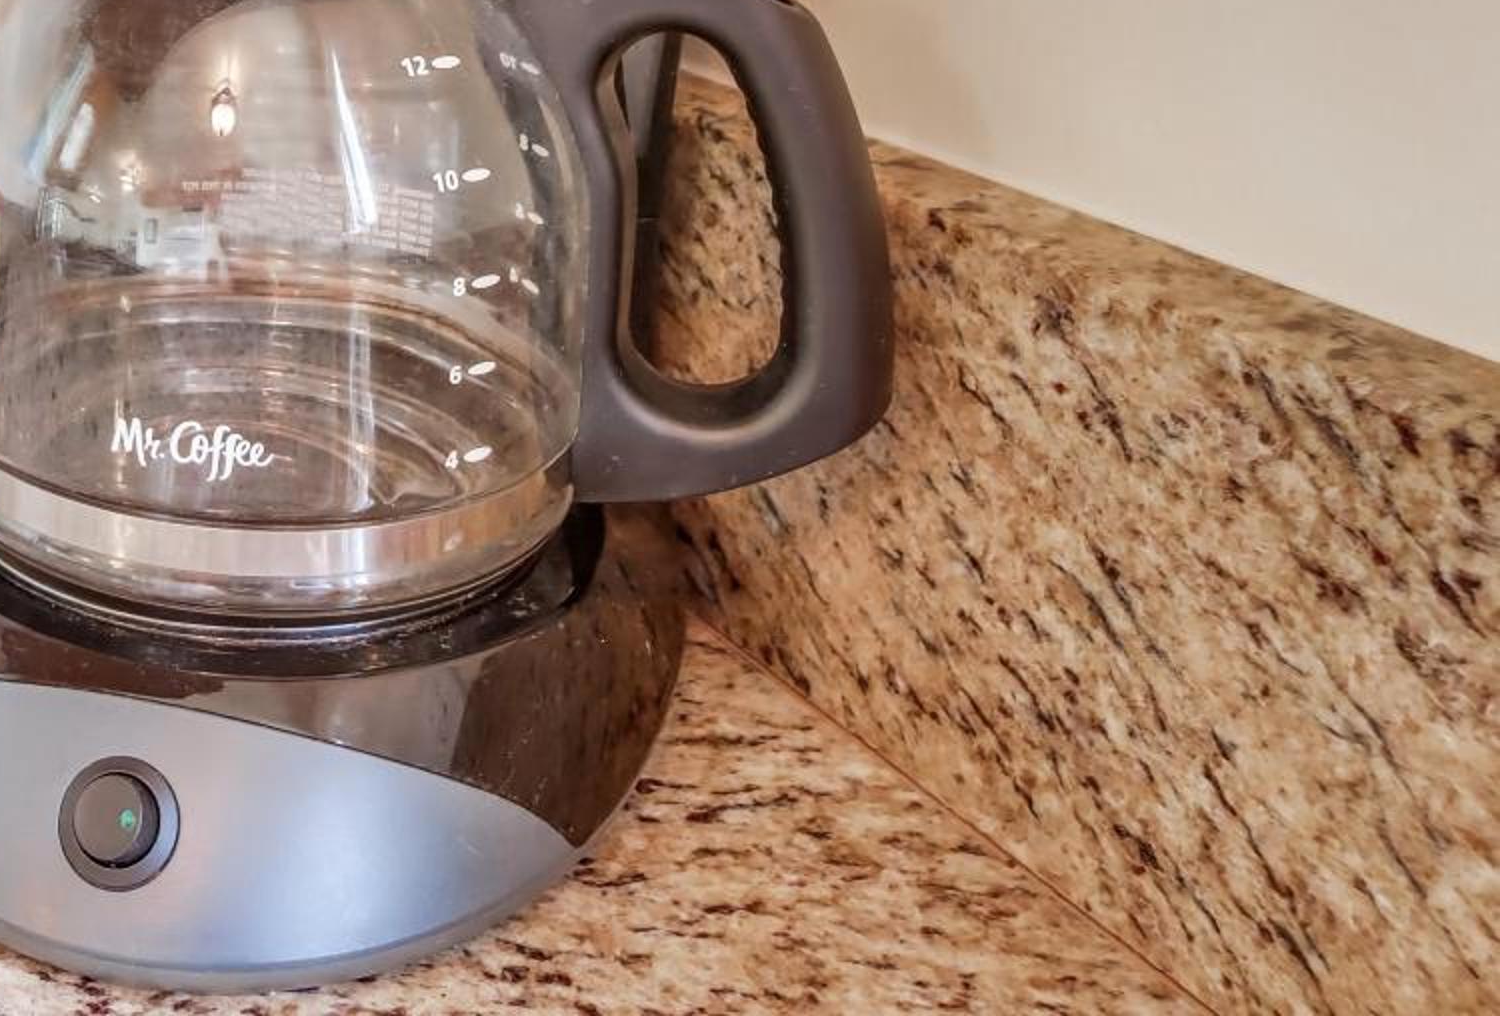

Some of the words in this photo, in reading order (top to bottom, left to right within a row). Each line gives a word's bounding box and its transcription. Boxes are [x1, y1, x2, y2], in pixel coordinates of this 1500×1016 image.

[400, 55, 431, 77] 12
[432, 169, 459, 193] 10
[452, 276, 467, 297] 8
[449, 364, 463, 385] 6
[110, 417, 165, 467] Mr.
[169, 421, 277, 482] Coffee
[444, 449, 459, 469] 4
